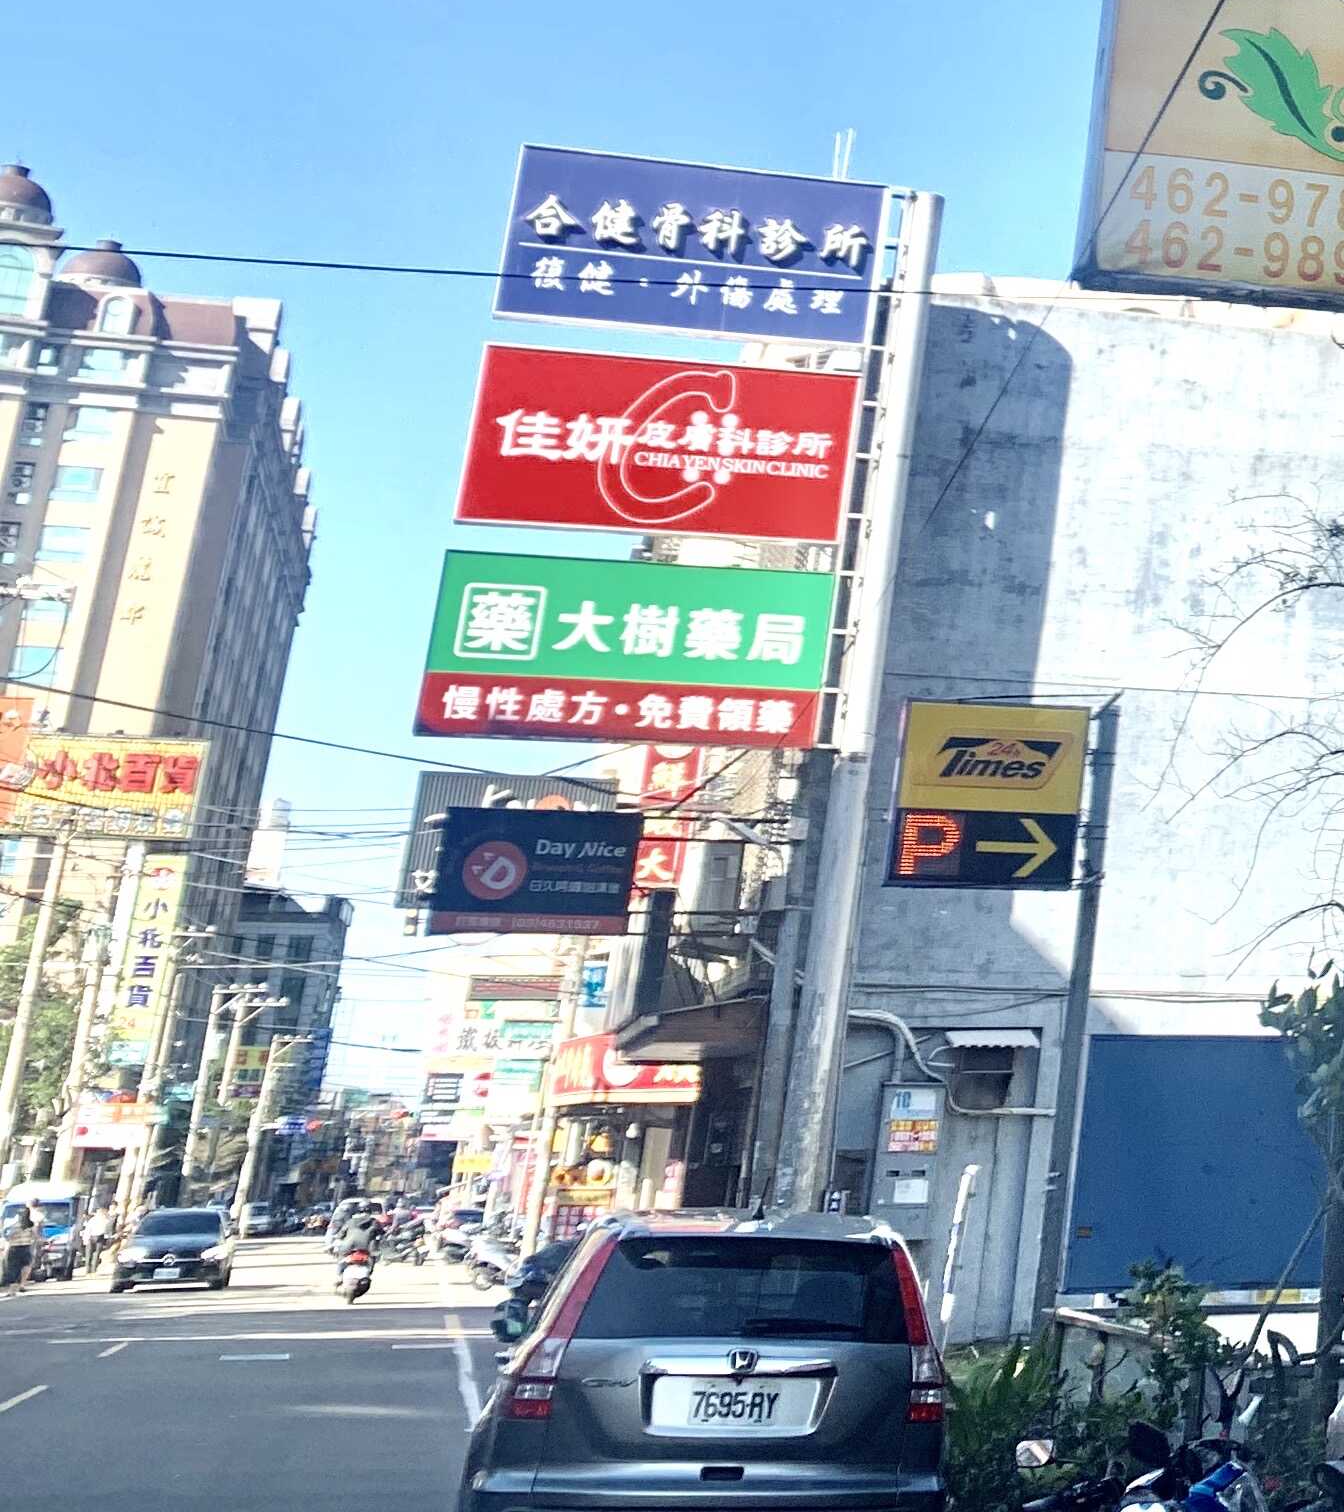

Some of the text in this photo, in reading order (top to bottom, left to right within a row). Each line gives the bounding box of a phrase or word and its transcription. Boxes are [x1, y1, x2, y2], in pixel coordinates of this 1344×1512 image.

[523, 192, 874, 269] 合健骨科診所
[634, 450, 830, 480] CHIA YEN SKIN CLINIC
[464, 590, 539, 653] 藥
[552, 599, 807, 666] 大樹藥局
[35, 748, 201, 794] 小北百貨
[937, 738, 1050, 780] Times
[534, 838, 627, 859] Day Nice
[898, 813, 962, 876] P
[691, 1390, 780, 1422] 7695-AY
